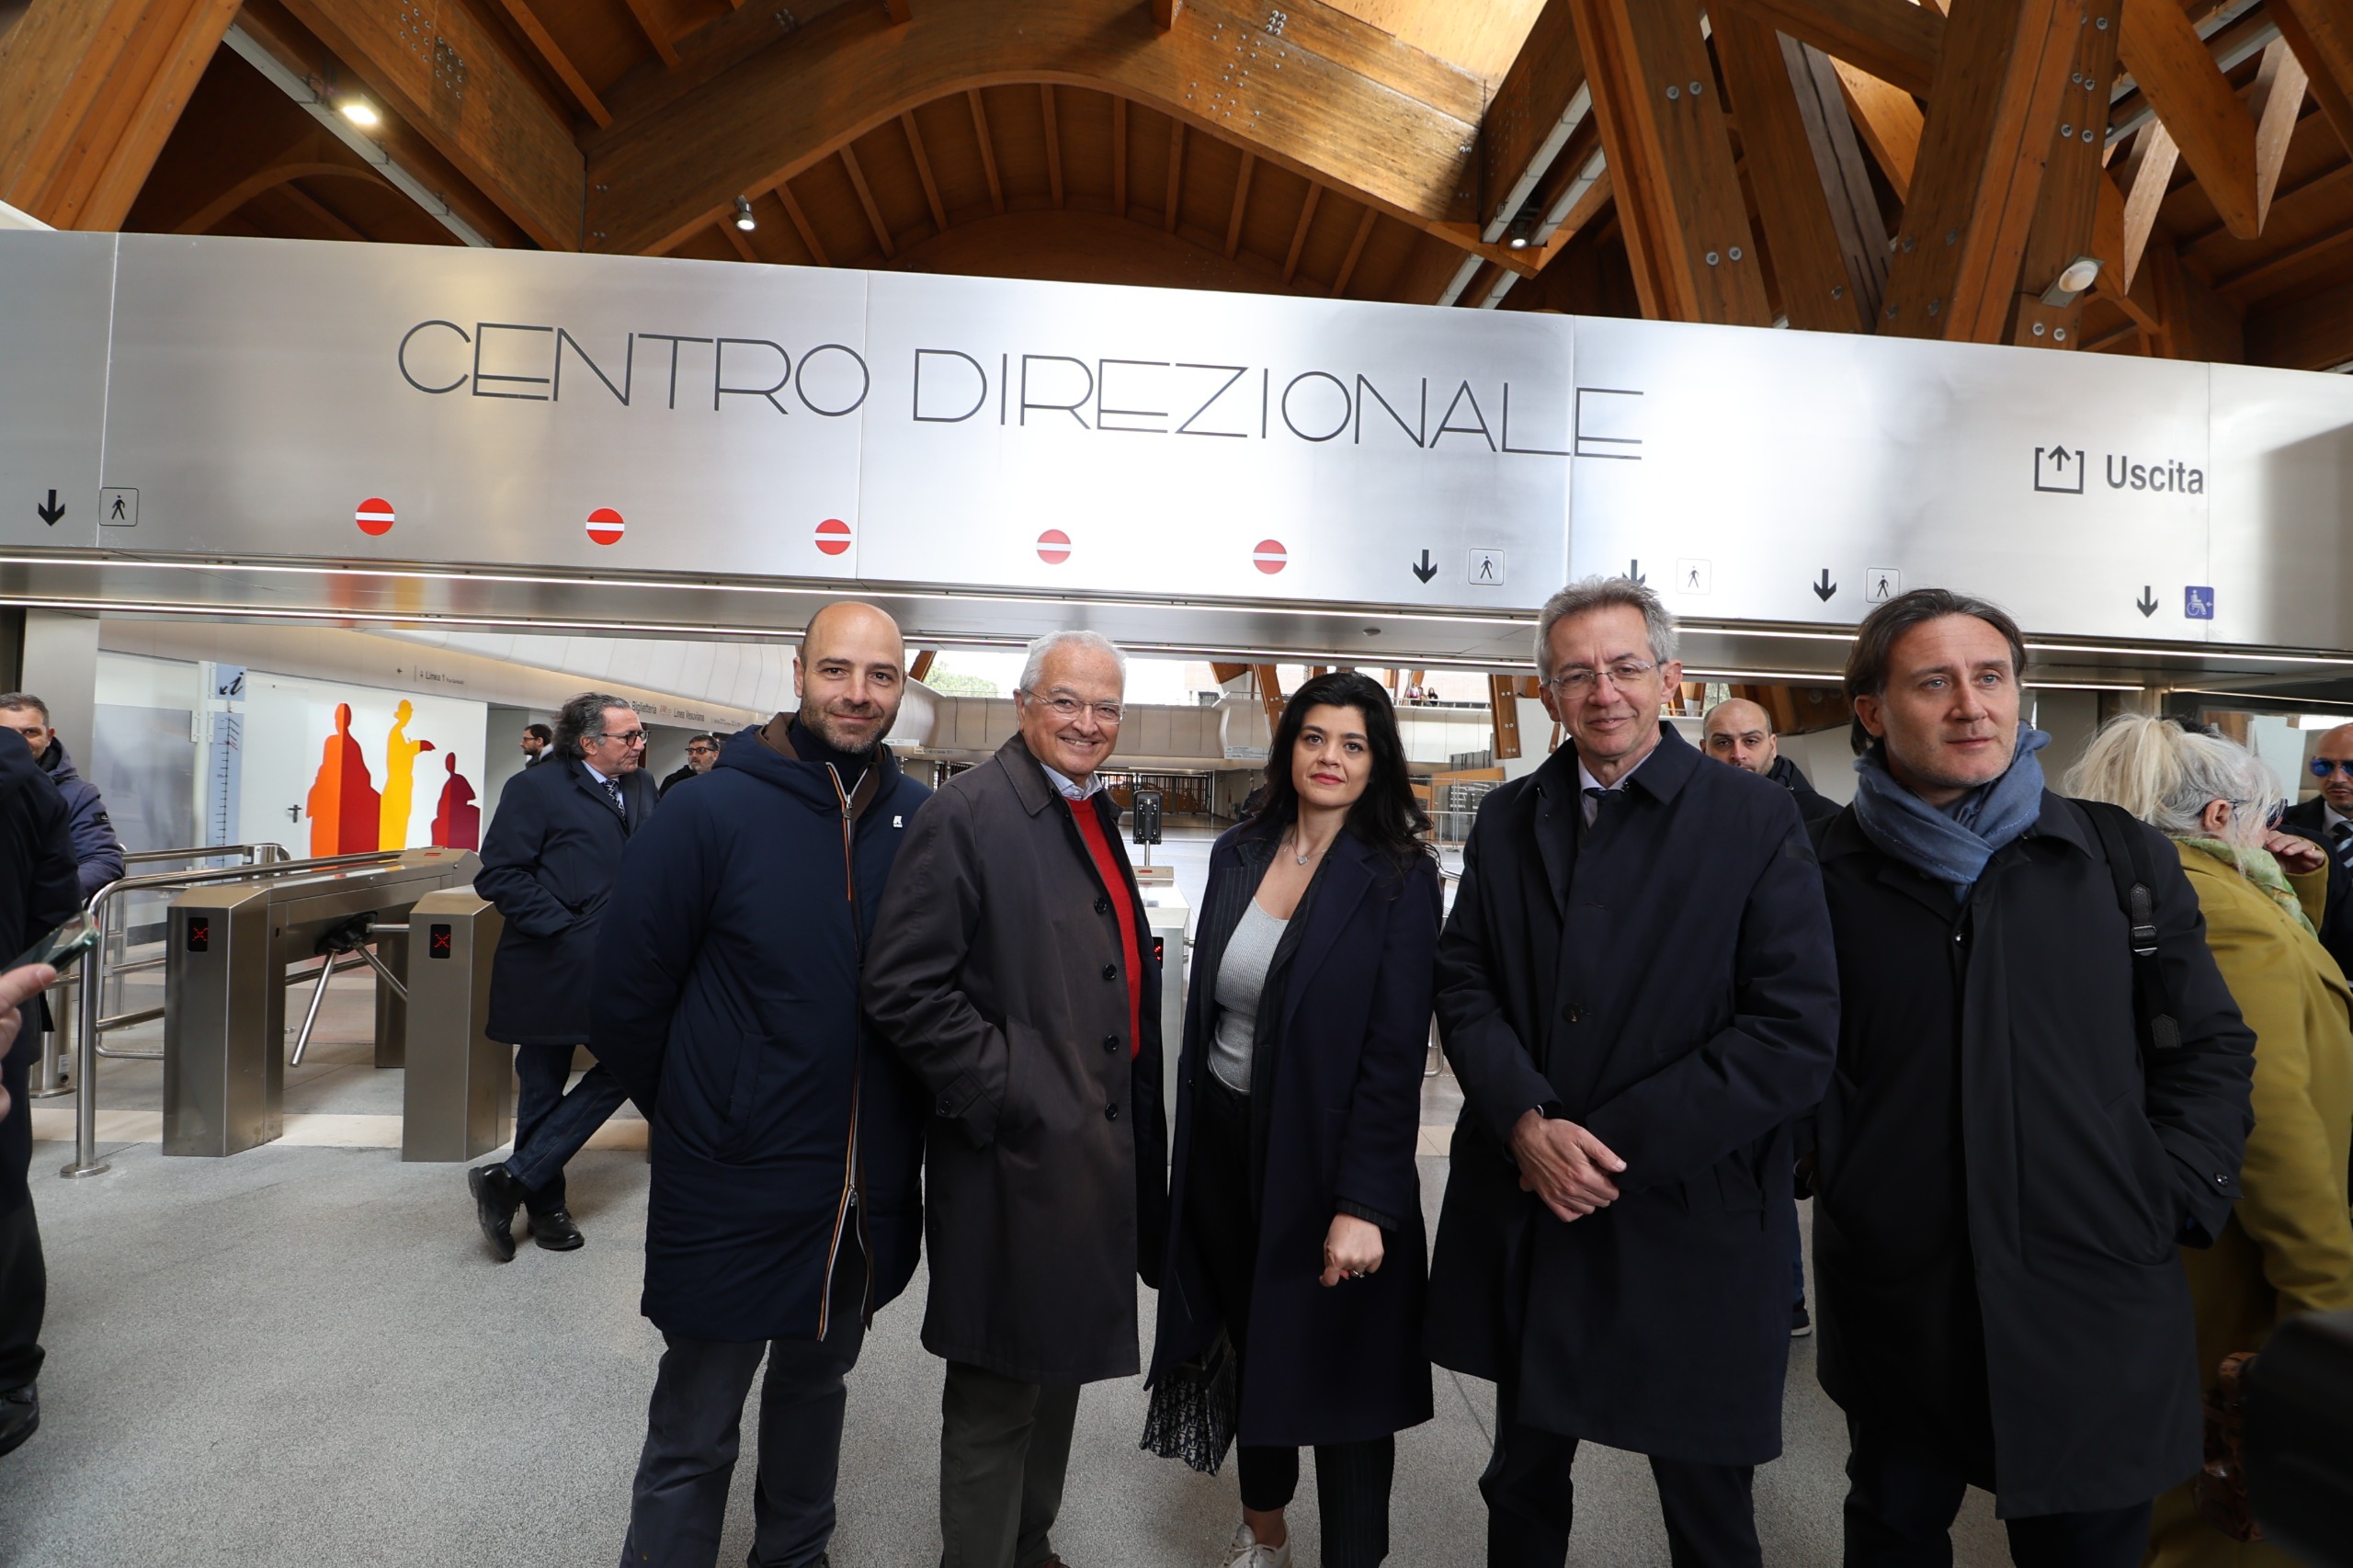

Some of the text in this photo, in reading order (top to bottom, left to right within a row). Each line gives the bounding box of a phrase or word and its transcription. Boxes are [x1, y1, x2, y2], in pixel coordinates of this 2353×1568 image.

[398, 319, 1644, 460] CENTRO DIREZIONALE
[2106, 454, 2204, 494] Uscita
[426, 671, 441, 681] Linea
[674, 708, 686, 720] Linea
